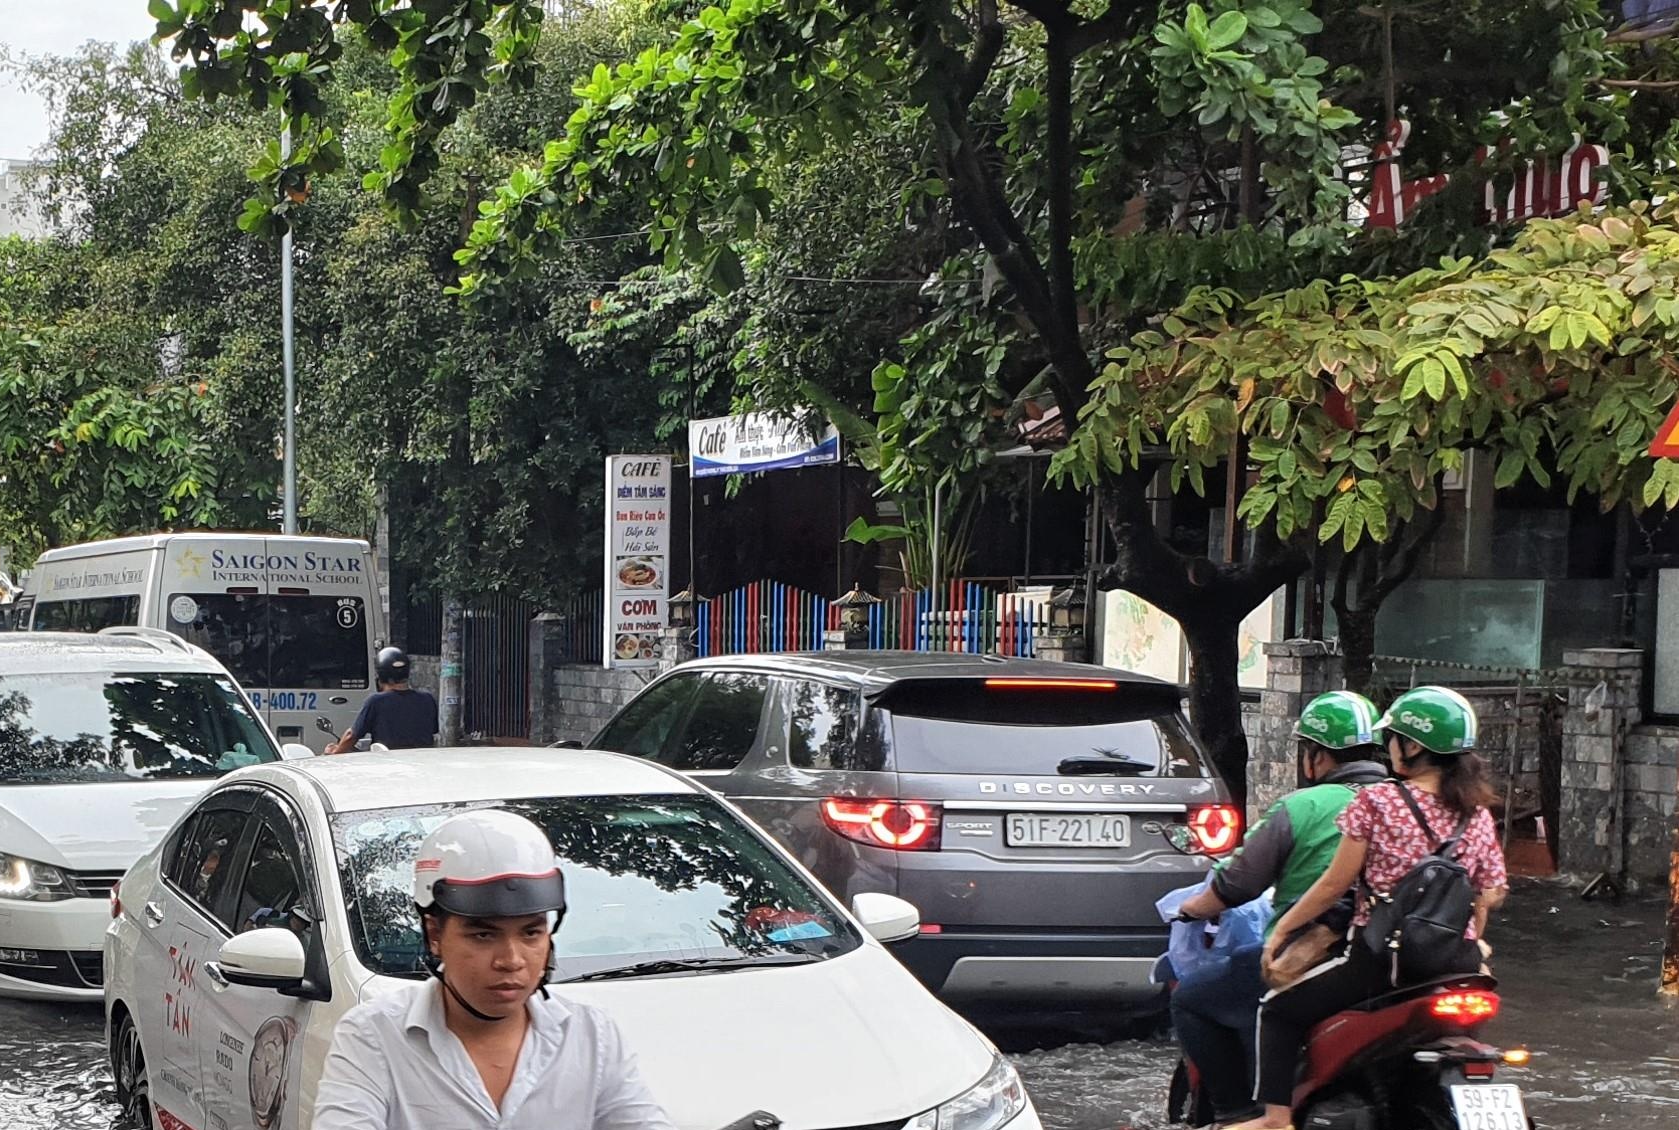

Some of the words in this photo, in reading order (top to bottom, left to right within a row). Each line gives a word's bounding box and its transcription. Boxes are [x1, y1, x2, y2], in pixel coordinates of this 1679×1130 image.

[212, 550, 299, 571] SAIGON
[304, 551, 361, 573] STAR
[212, 570, 311, 584] INTERNATIONAL
[315, 573, 363, 585] SCHOOL
[343, 609, 352, 623] 5
[1399, 710, 1434, 733] Grab
[979, 782, 1155, 796] DISCOVERY
[946, 821, 993, 830] SPORT
[1012, 818, 1125, 843] 51F-221.40
[1462, 1088, 1512, 1109] 59-F2
